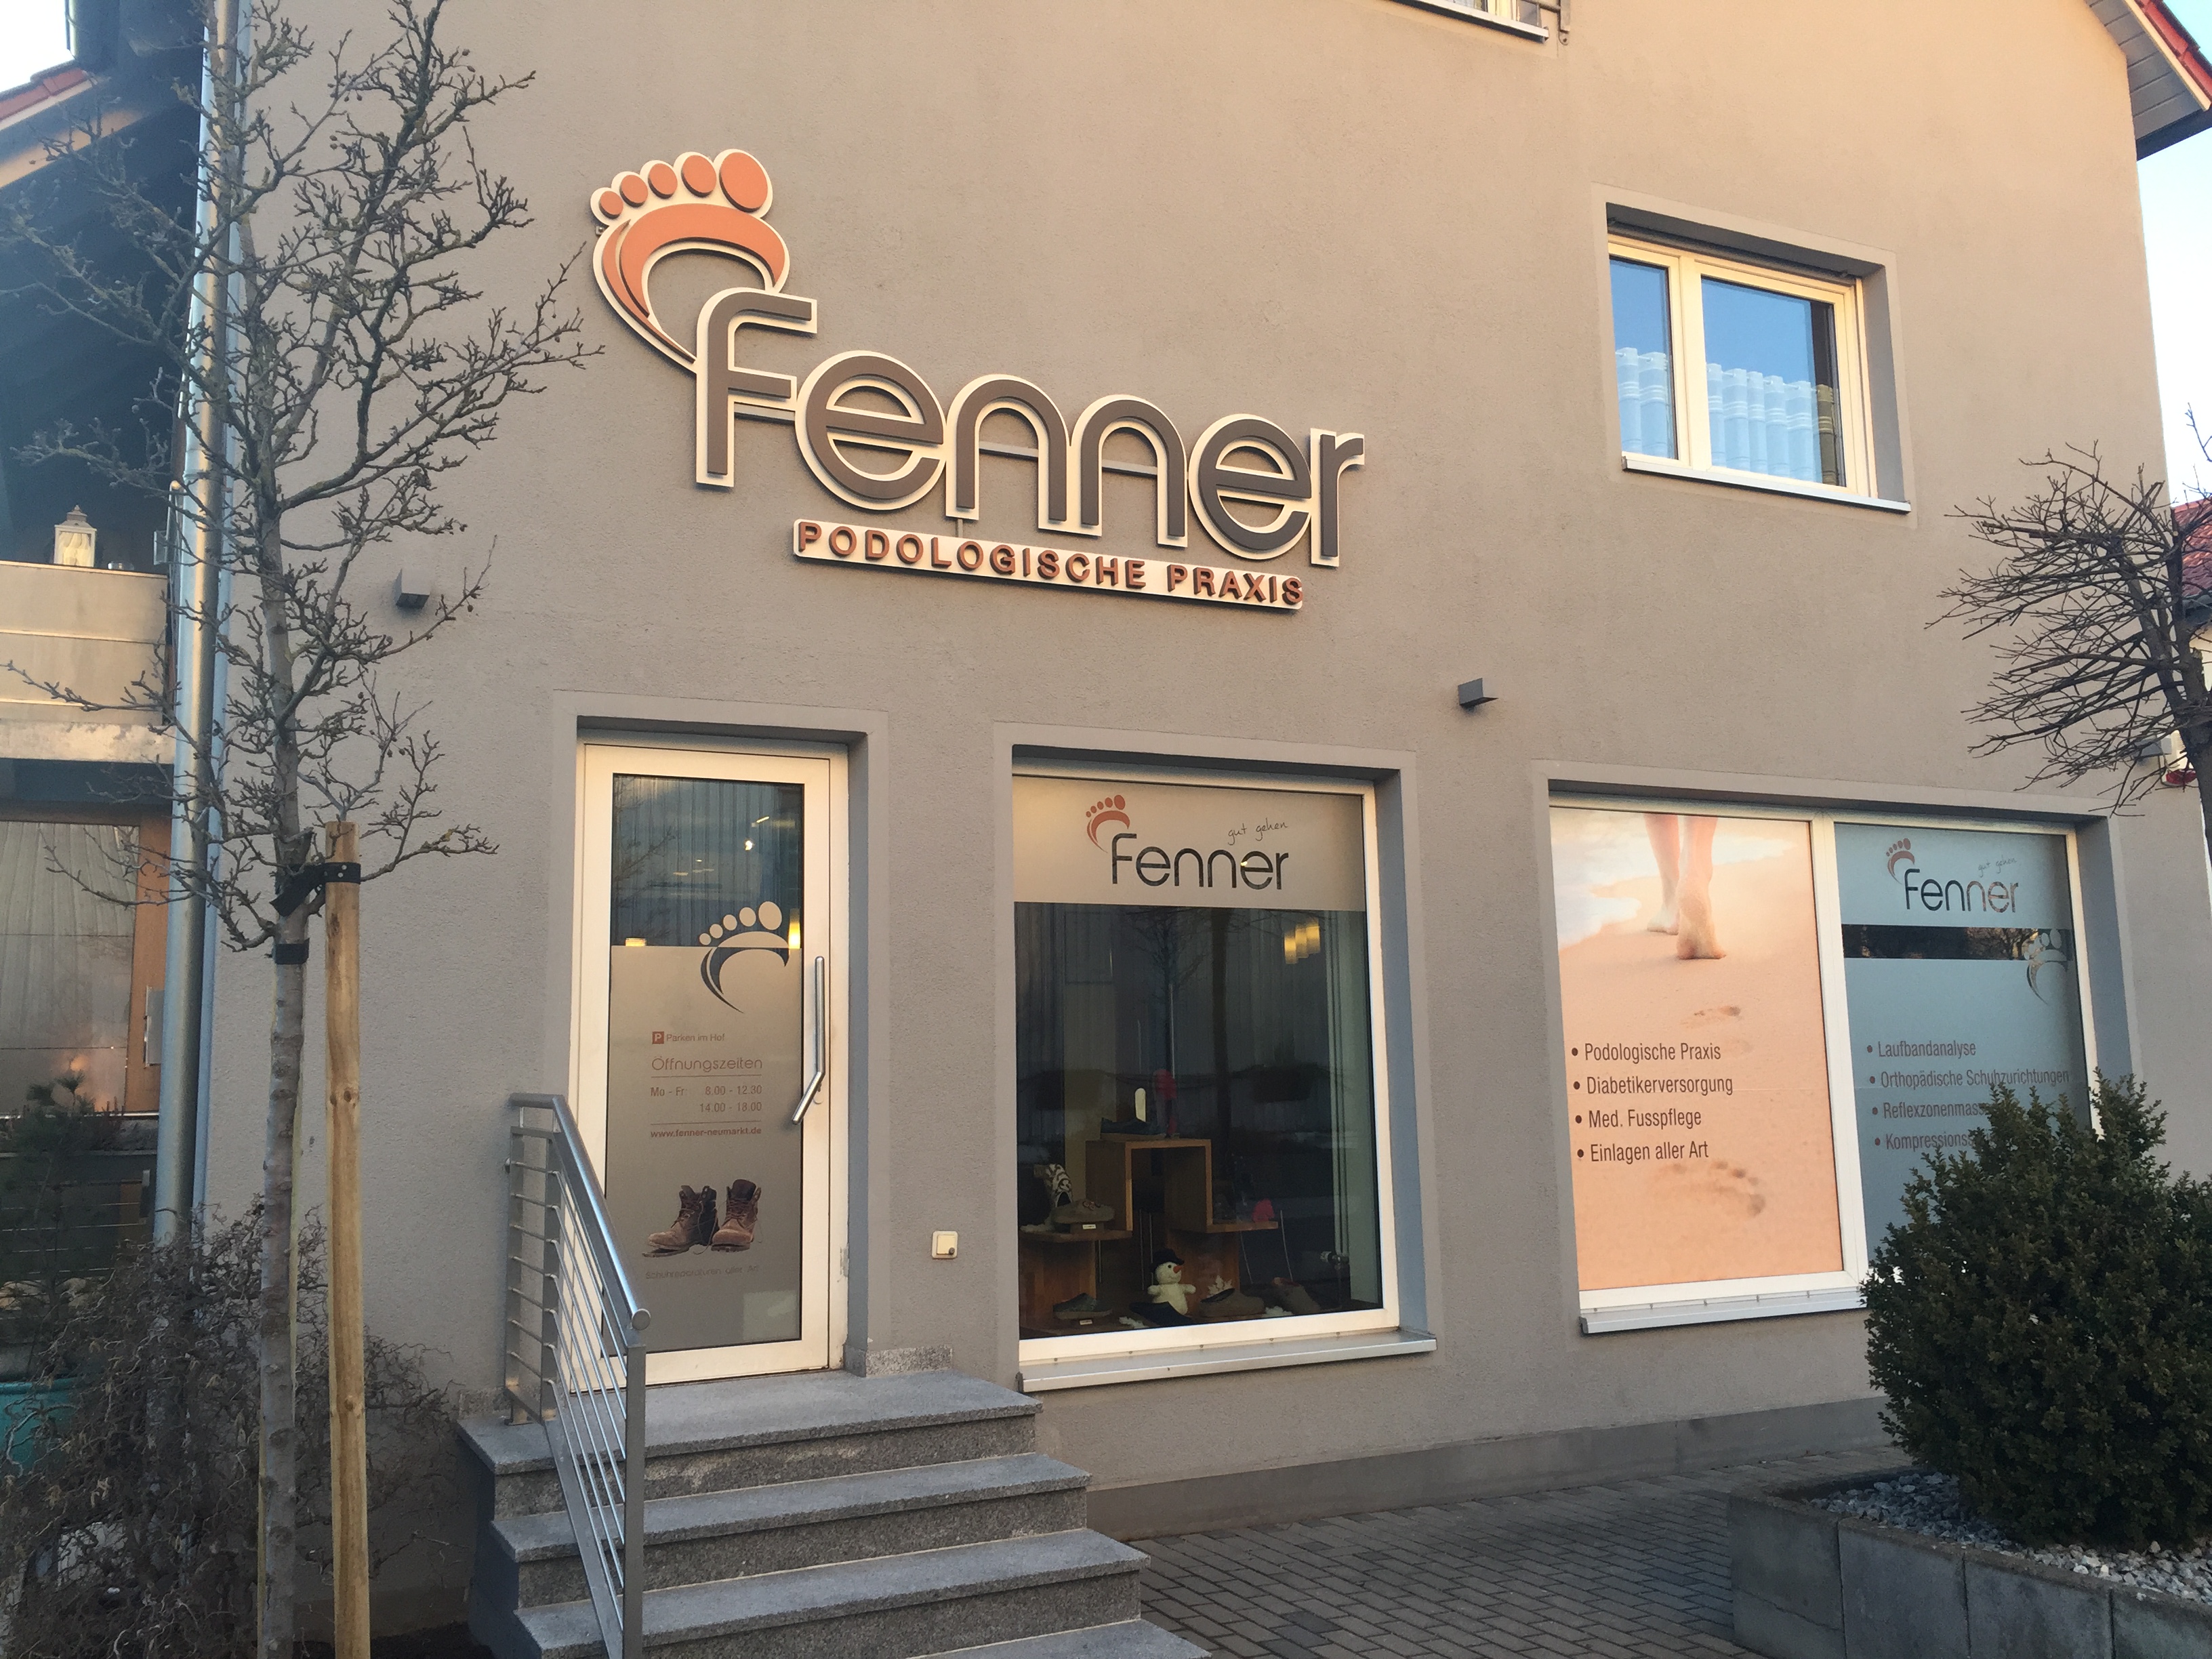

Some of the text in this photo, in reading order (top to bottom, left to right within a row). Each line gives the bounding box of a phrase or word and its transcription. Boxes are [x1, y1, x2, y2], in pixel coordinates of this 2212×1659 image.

[698, 289, 1364, 567] Fenner
[798, 520, 1304, 605] PODOLOGISCHE PRAXIS
[1227, 817, 1289, 846] gut gehen
[1111, 832, 1289, 890] Fenner
[1904, 867, 2019, 914] Fenner
[666, 1033, 695, 1042] Parken
[697, 1033, 708, 1042] im
[710, 1033, 726, 1042] Hof
[1584, 1042, 1721, 1065] Podologische Praxis
[1877, 1040, 1977, 1059] Laufbandanalyse
[651, 1055, 763, 1073] Öffnungszeiten
[1586, 1075, 1734, 1097] Diabetikerversorgung
[1880, 1067, 2070, 1090] Orthopädische Schuhzurichtungen
[650, 1086, 665, 1097] Mo
[704, 1085, 726, 1096] 8.00
[737, 1084, 762, 1095] 12.30
[699, 1102, 726, 1113] 14.00
[737, 1101, 763, 1112] 18.00
[1588, 1108, 1702, 1130] Med. Fusspflege
[651, 1126, 762, 1139] www.fenner-neumarkt.de
[1590, 1140, 1709, 1165] Einlagen aller Art
